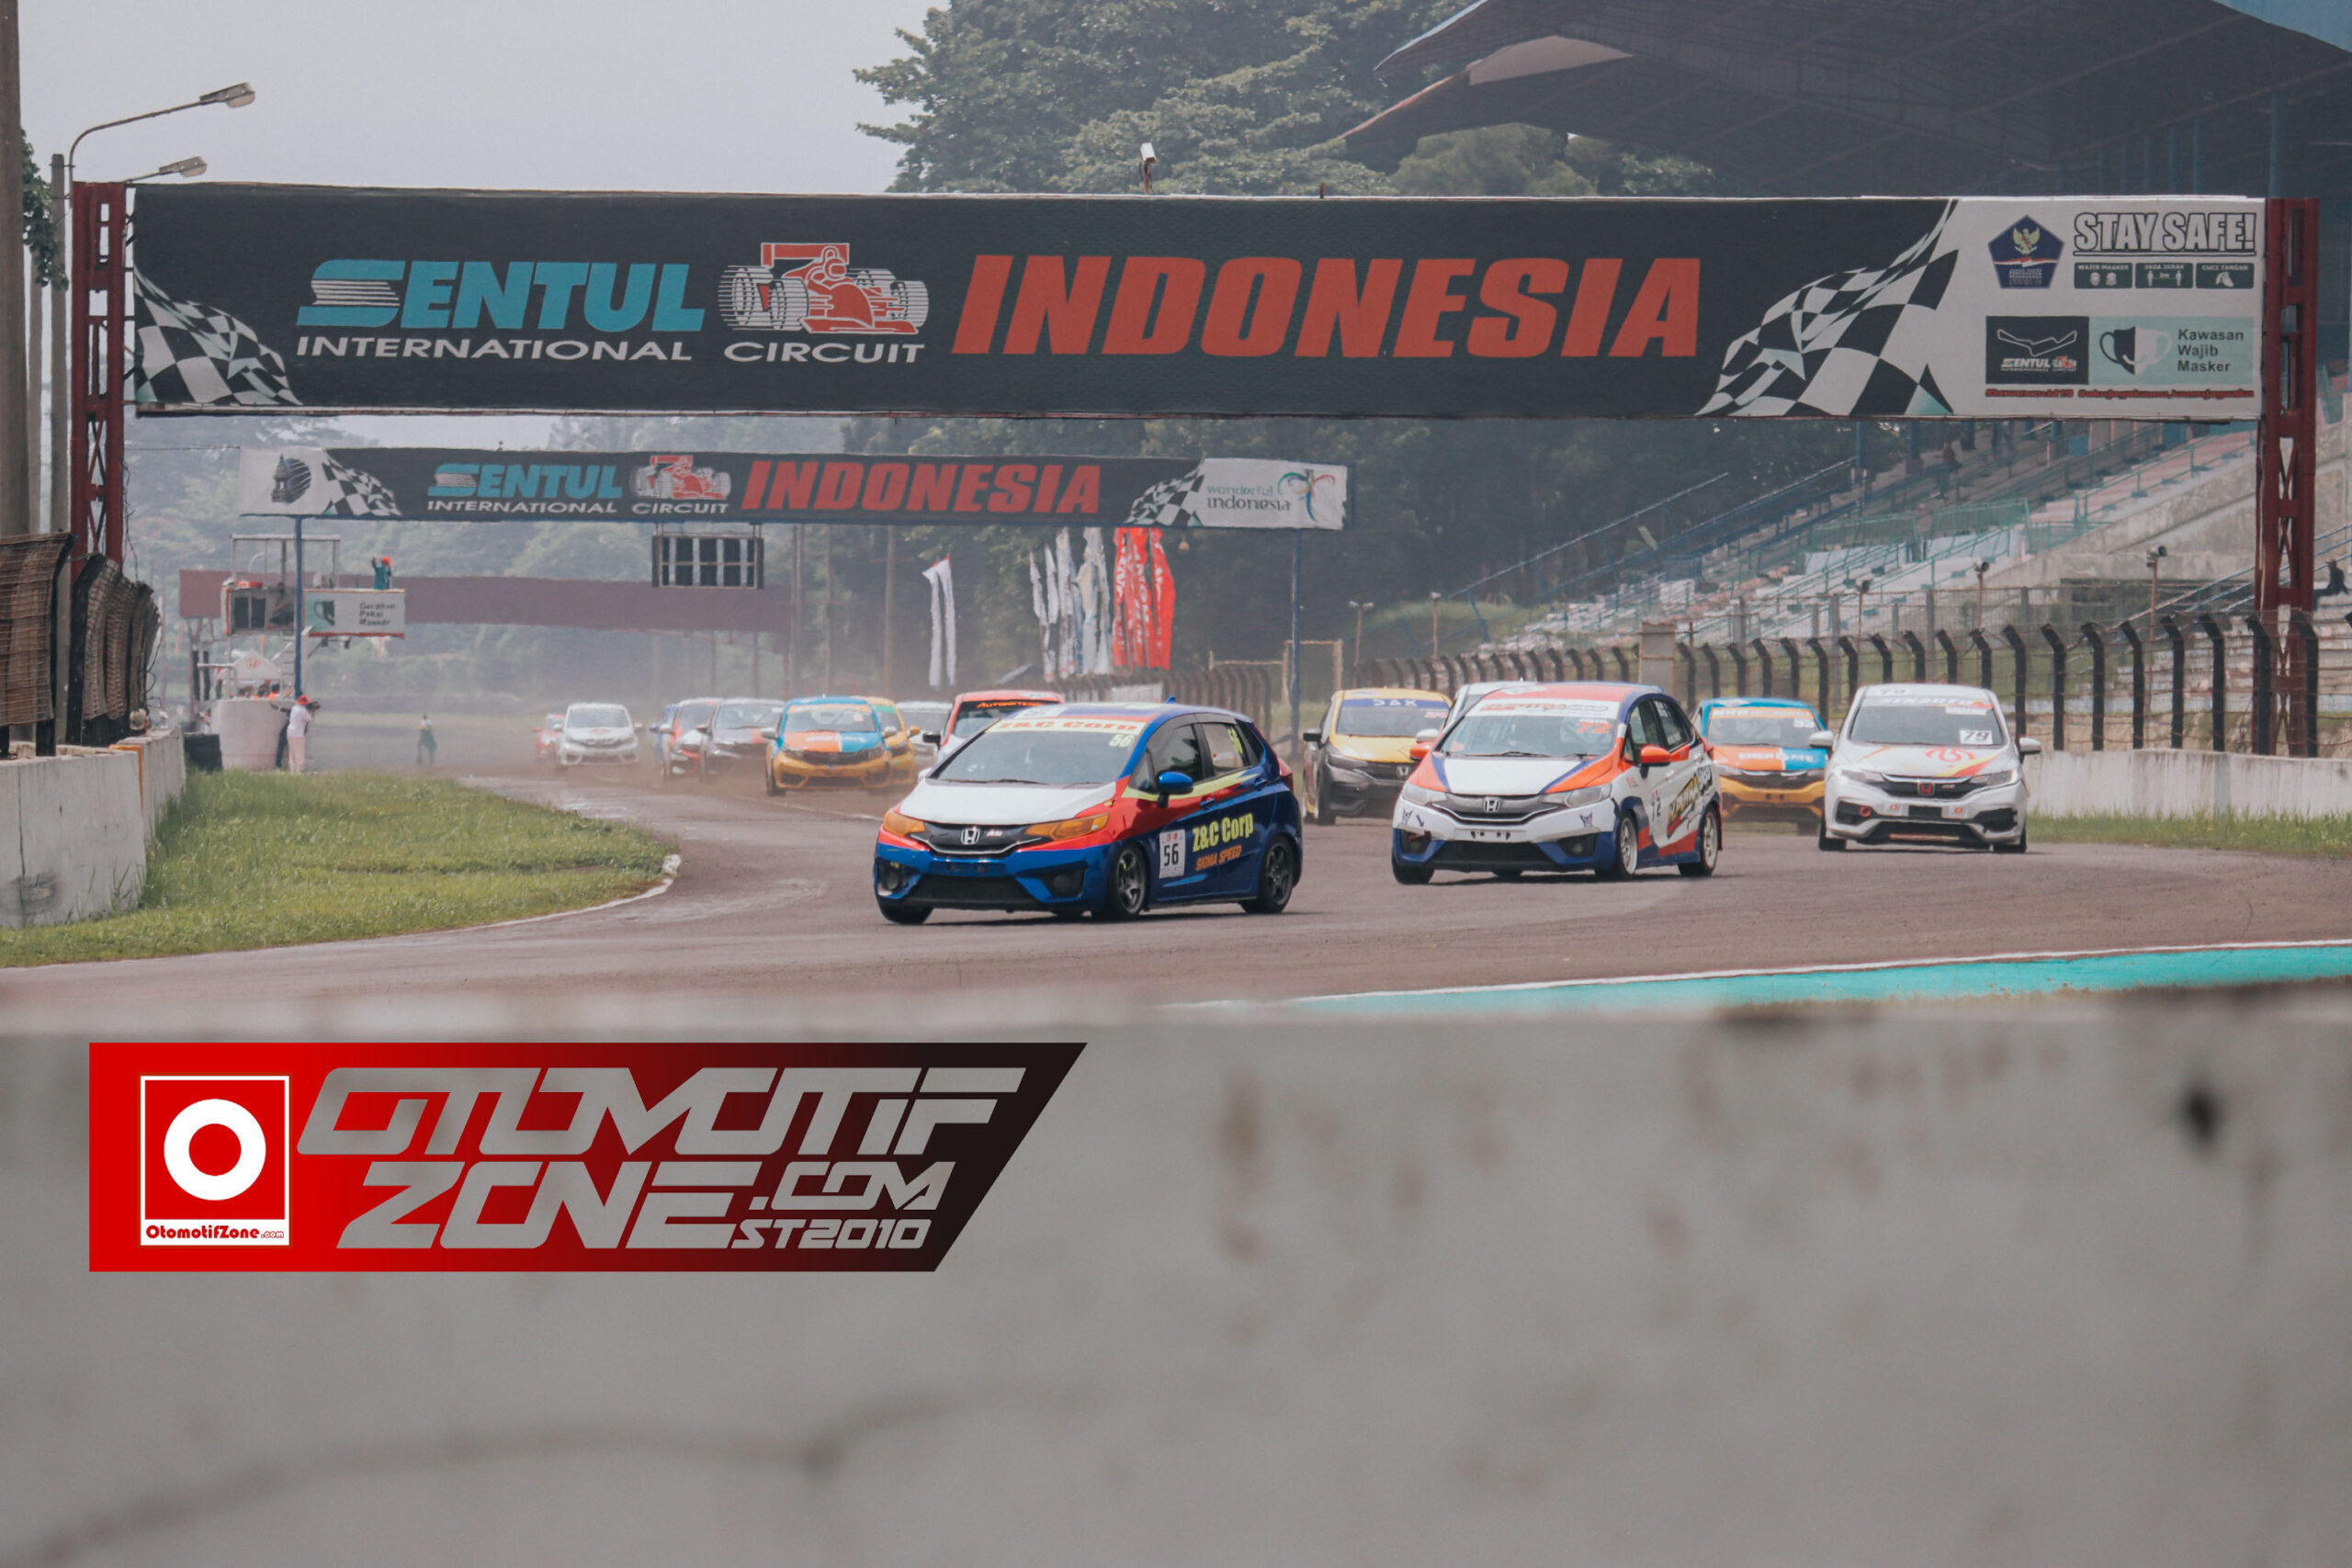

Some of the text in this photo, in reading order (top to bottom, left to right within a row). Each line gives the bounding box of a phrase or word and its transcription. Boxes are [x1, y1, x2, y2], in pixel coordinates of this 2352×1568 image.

[2074, 212, 2256, 251] STAY SAFE!
[297, 258, 705, 333] SENTUL
[952, 254, 1701, 358] INDONESIA
[2177, 329, 2245, 341] Kawasan
[297, 335, 924, 364] INTERNATIONAL CIRCUIT
[2177, 344, 2219, 359] Wajib
[2001, 357, 2052, 367] SENTUL
[2177, 359, 2231, 372] Masker
[427, 462, 623, 499] SENTUL
[741, 460, 1102, 515] INDONESIA
[1206, 484, 1273, 496] wonderful
[427, 500, 729, 514] INTERNATIONAL CIRCUIT
[1206, 494, 1292, 512] indonesia
[1109, 734, 1136, 748] 56
[1192, 813, 1254, 852] Z&C Corp
[1164, 842, 1180, 867] 56
